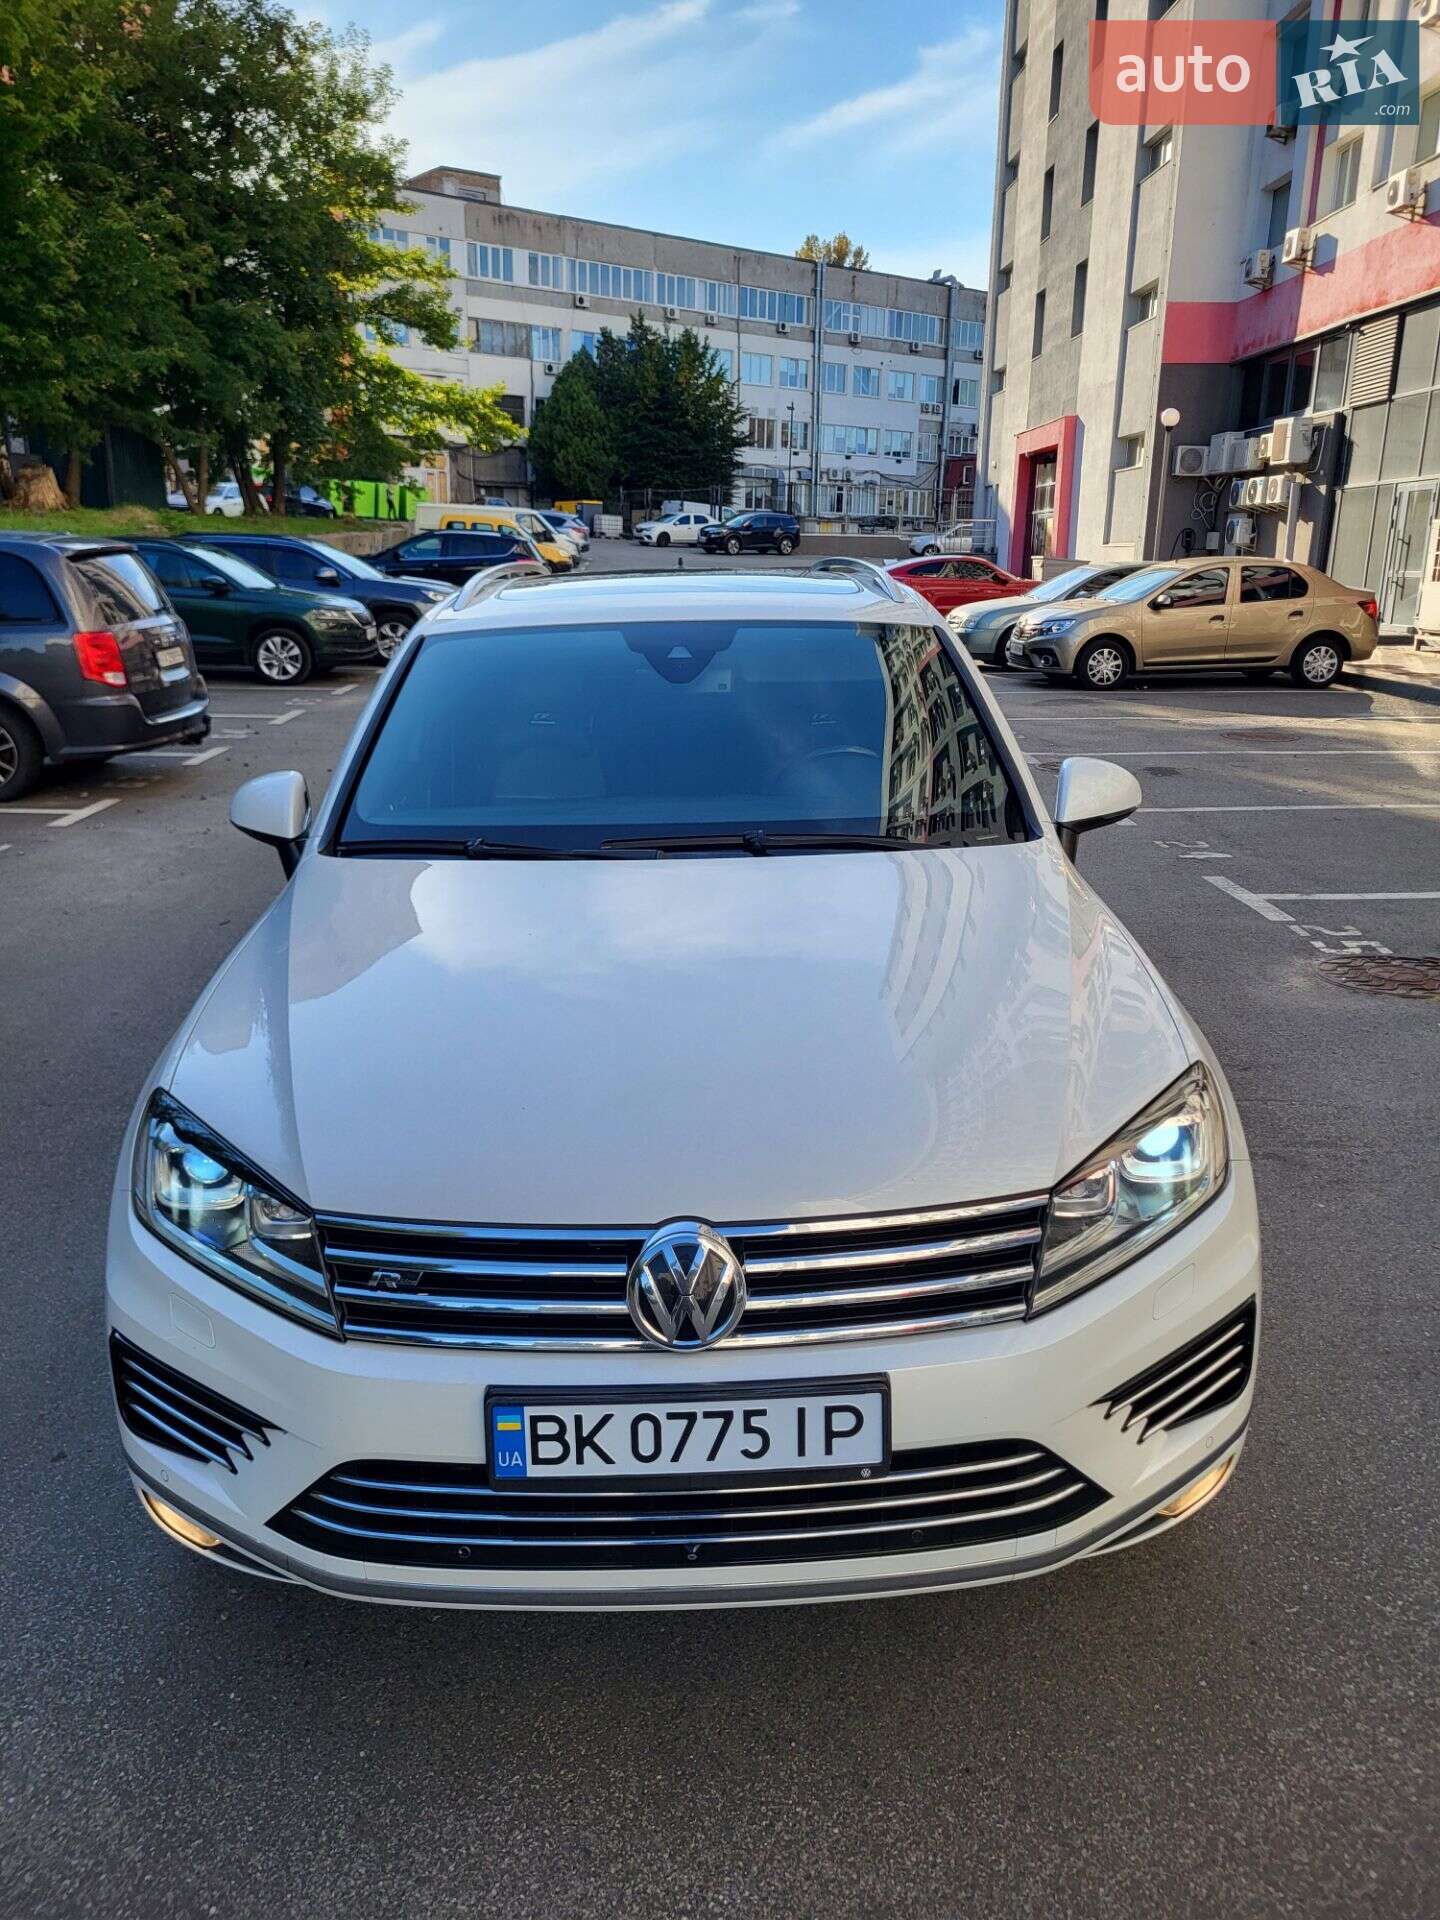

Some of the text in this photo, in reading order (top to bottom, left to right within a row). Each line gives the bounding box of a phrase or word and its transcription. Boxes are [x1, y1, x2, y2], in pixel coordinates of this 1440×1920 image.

[530, 1404, 865, 1466] BK 0775 IP
[498, 1450, 523, 1467] UA
